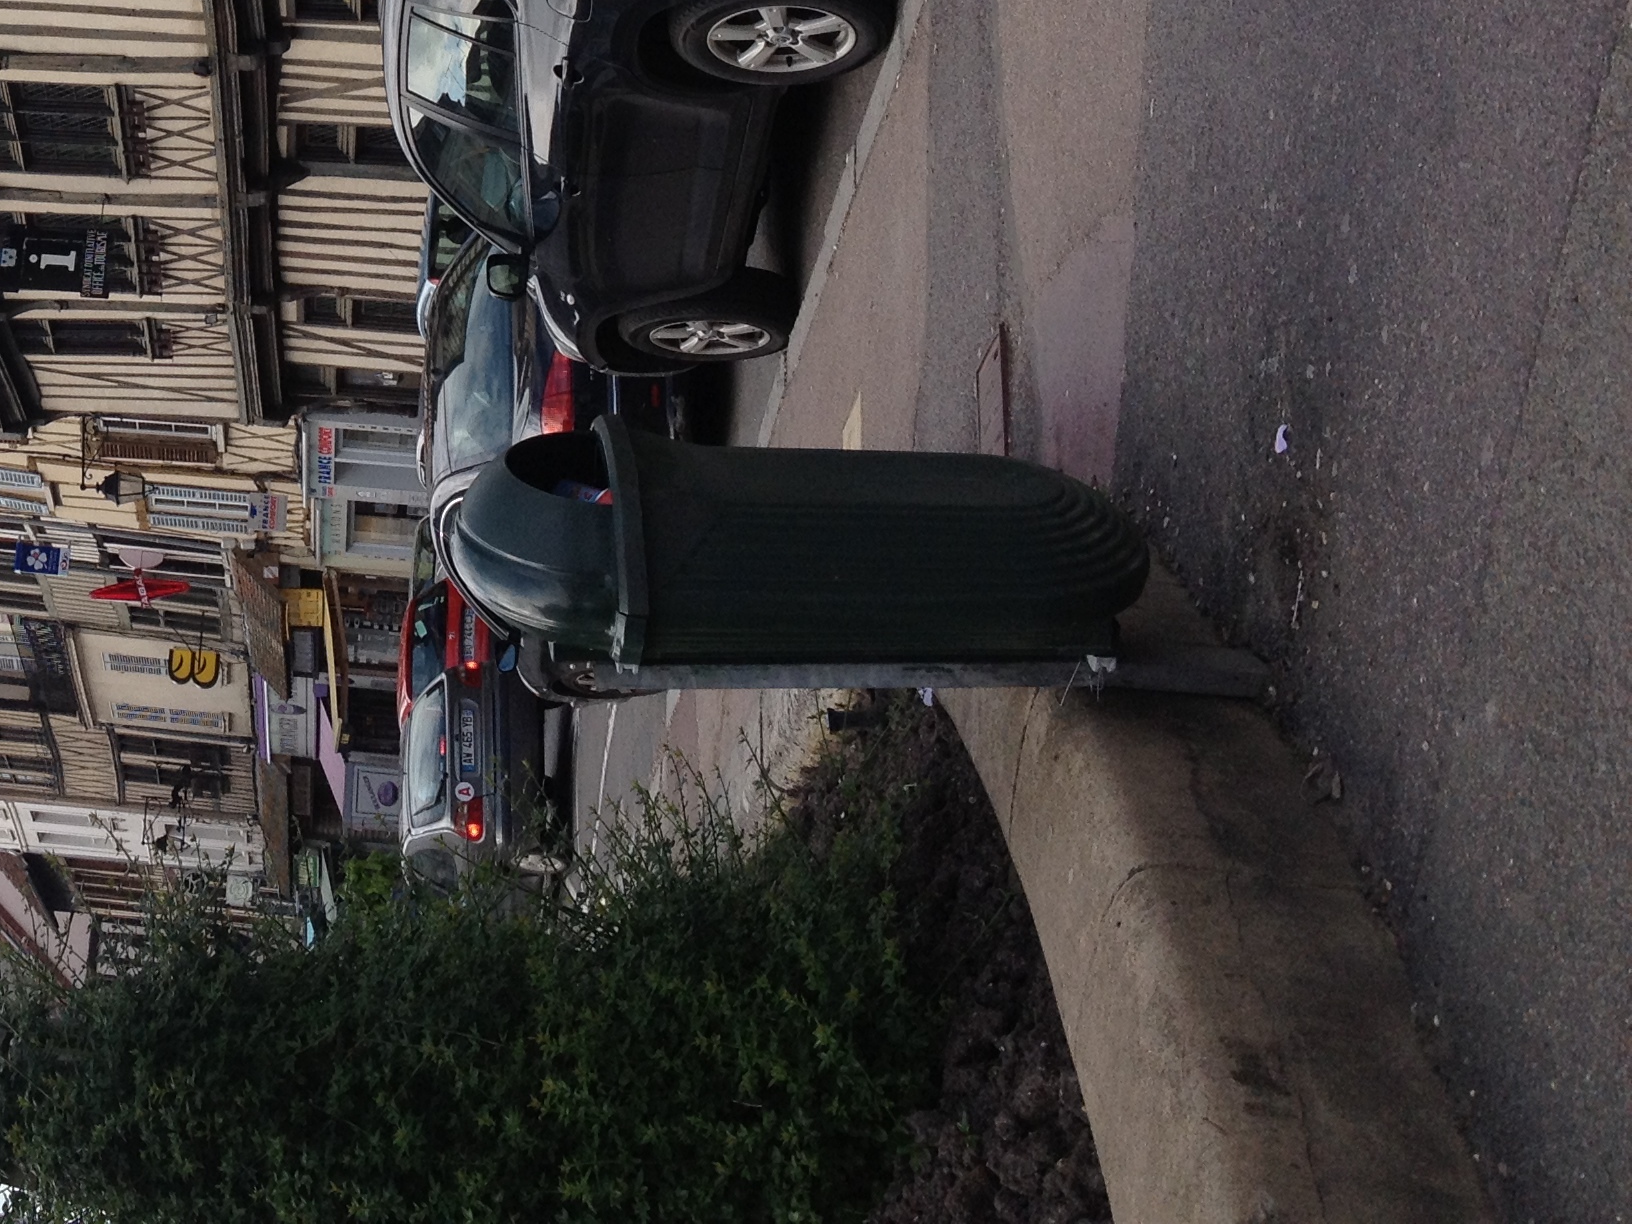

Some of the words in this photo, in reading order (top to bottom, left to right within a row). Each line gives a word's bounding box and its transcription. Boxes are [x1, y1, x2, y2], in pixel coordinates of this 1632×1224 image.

[29, 250, 76, 271] i
[94, 230, 108, 264] TOURISME
[81, 268, 92, 298] SYNDICAT
[90, 271, 104, 295] OFFICE
[318, 426, 332, 455] CONFORT
[318, 456, 332, 484] FRANCE
[262, 494, 270, 529] FRANCE
[269, 495, 277, 530] CONFORT
[330, 504, 342, 544] MAISONS
[458, 786, 471, 797] A
